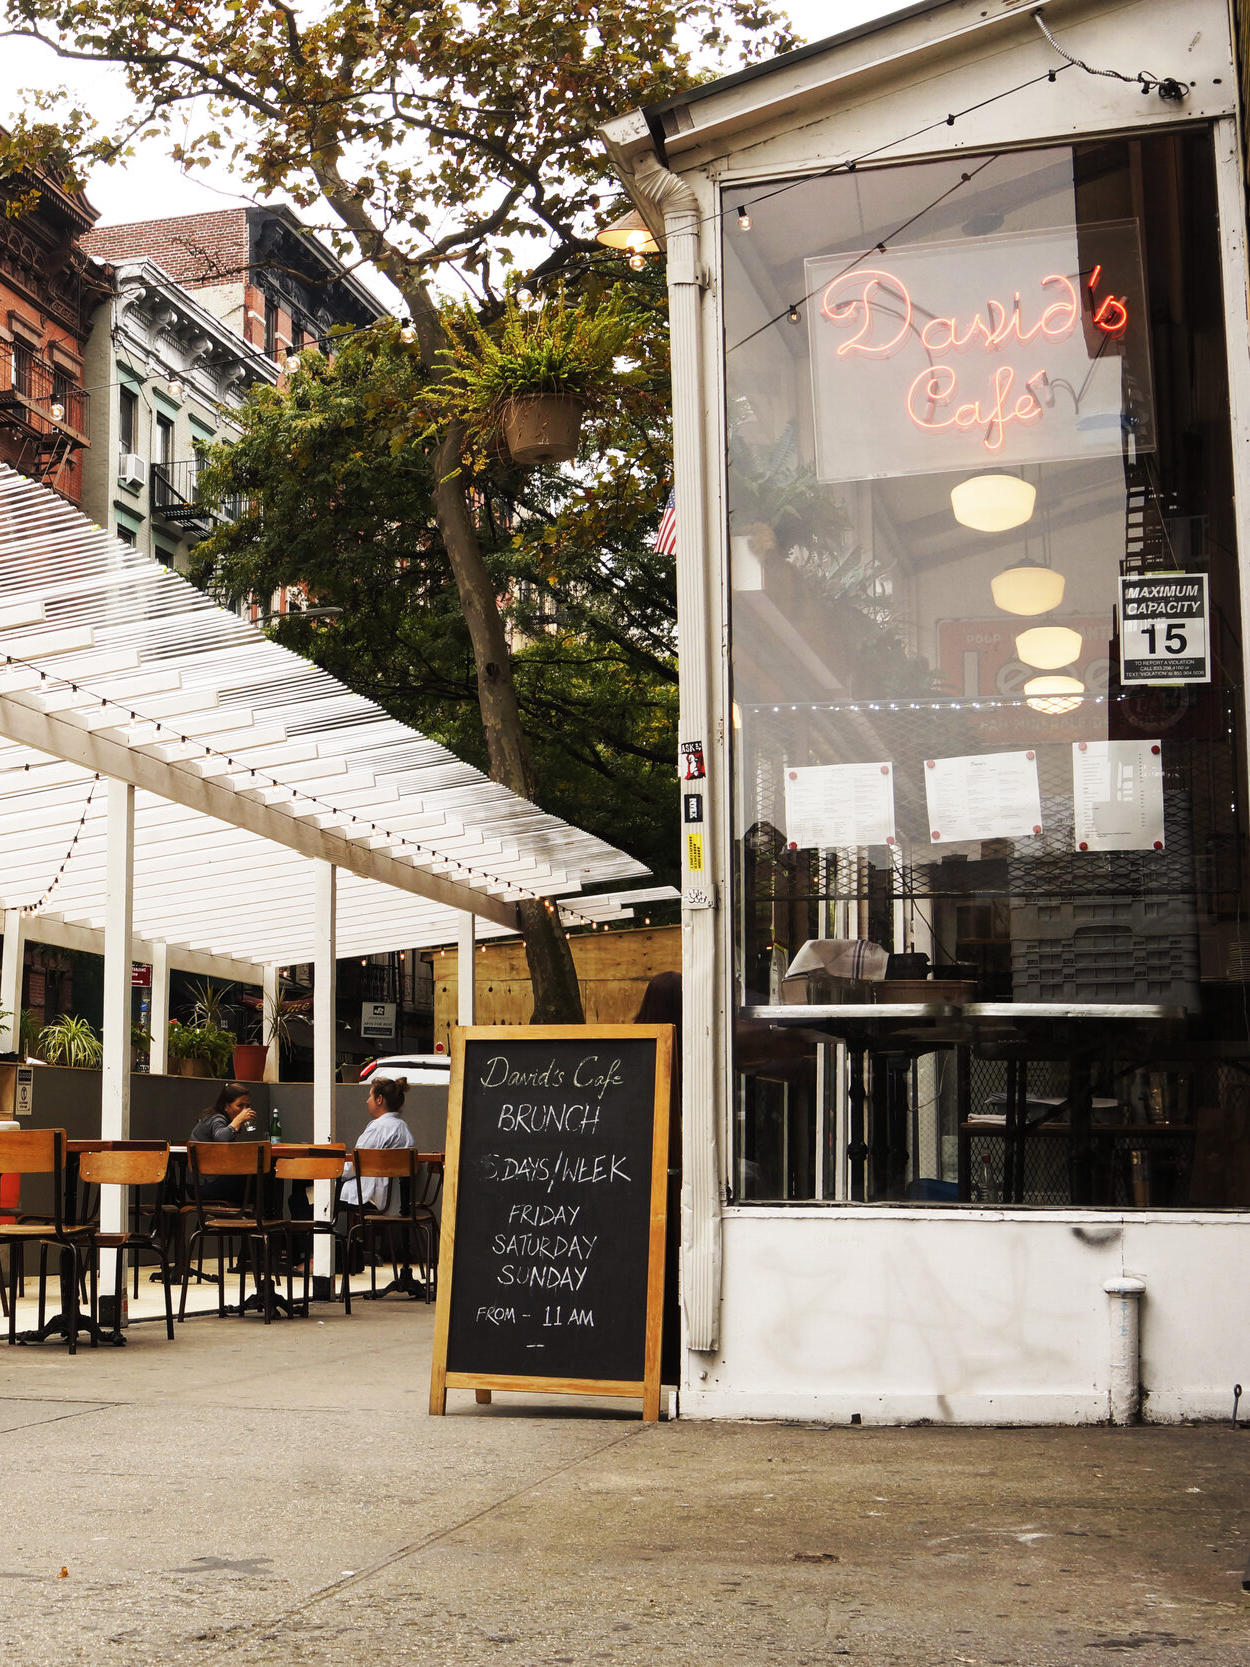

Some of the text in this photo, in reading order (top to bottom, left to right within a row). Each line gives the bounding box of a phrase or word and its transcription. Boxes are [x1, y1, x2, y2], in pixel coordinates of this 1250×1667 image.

[822, 265, 1127, 356] David's
[1127, 585, 1199, 599] MAXIMUM
[1127, 601, 1201, 615] CAPACITY
[1141, 623, 1188, 654] 15
[480, 1055, 624, 1099] David's Cafe
[498, 1103, 601, 1134] BRUNCH
[508, 1204, 581, 1226] FRIDAY
[492, 1234, 598, 1260] SATURDAY
[497, 1264, 588, 1291] SUNDAY
[476, 1307, 516, 1326] FROM
[542, 1305, 563, 1327] 11
[567, 1307, 595, 1327] AM
